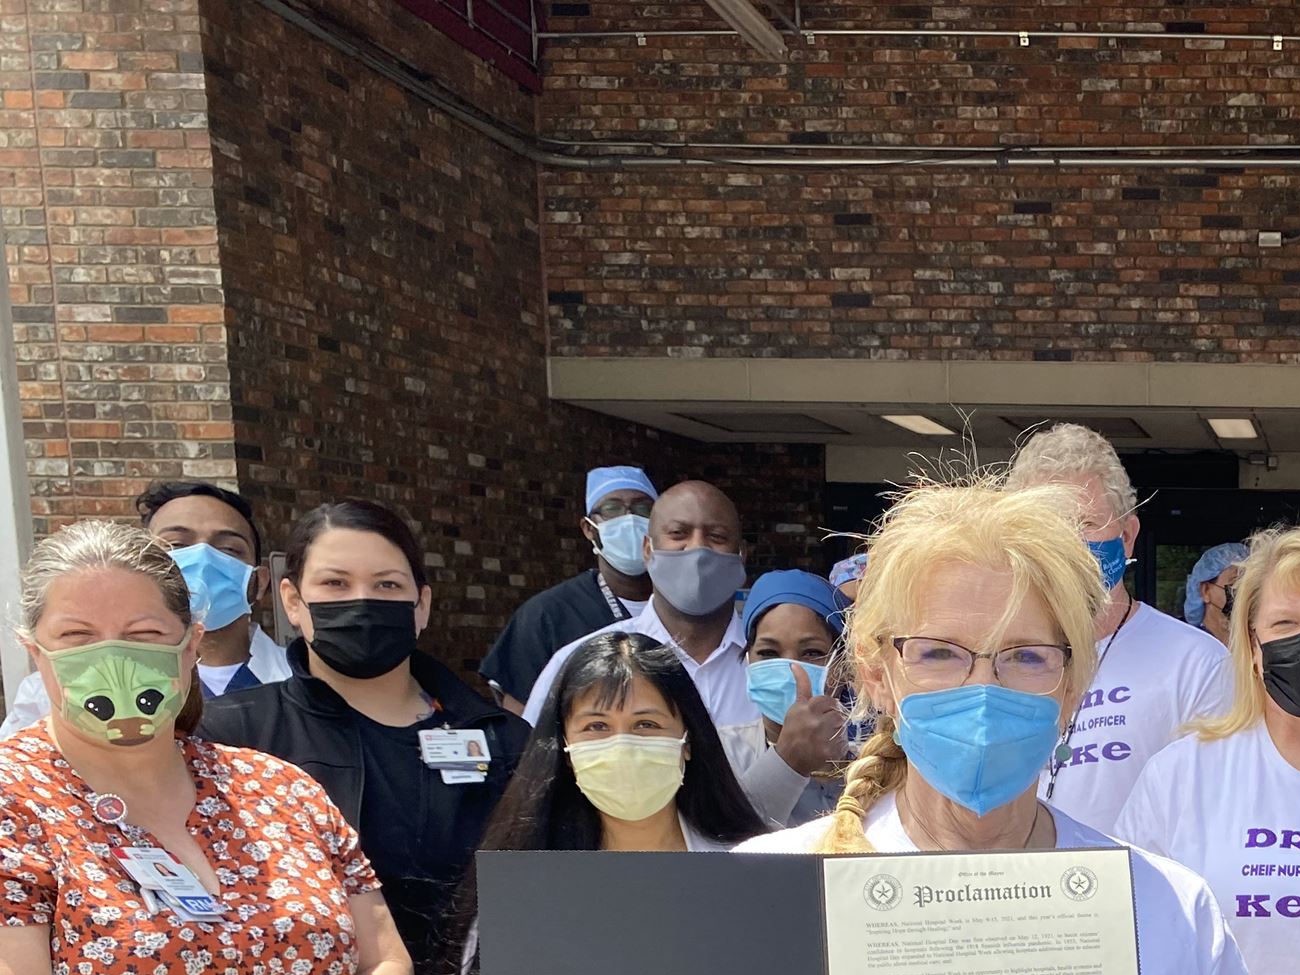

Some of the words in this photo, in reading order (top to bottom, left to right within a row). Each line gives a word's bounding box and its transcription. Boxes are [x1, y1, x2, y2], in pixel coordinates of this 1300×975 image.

[1088, 714, 1126, 730] OFFICER
[1242, 864, 1276, 876] CHEIF
[912, 881, 1053, 908] Proclamation
[185, 899, 214, 912] RN
